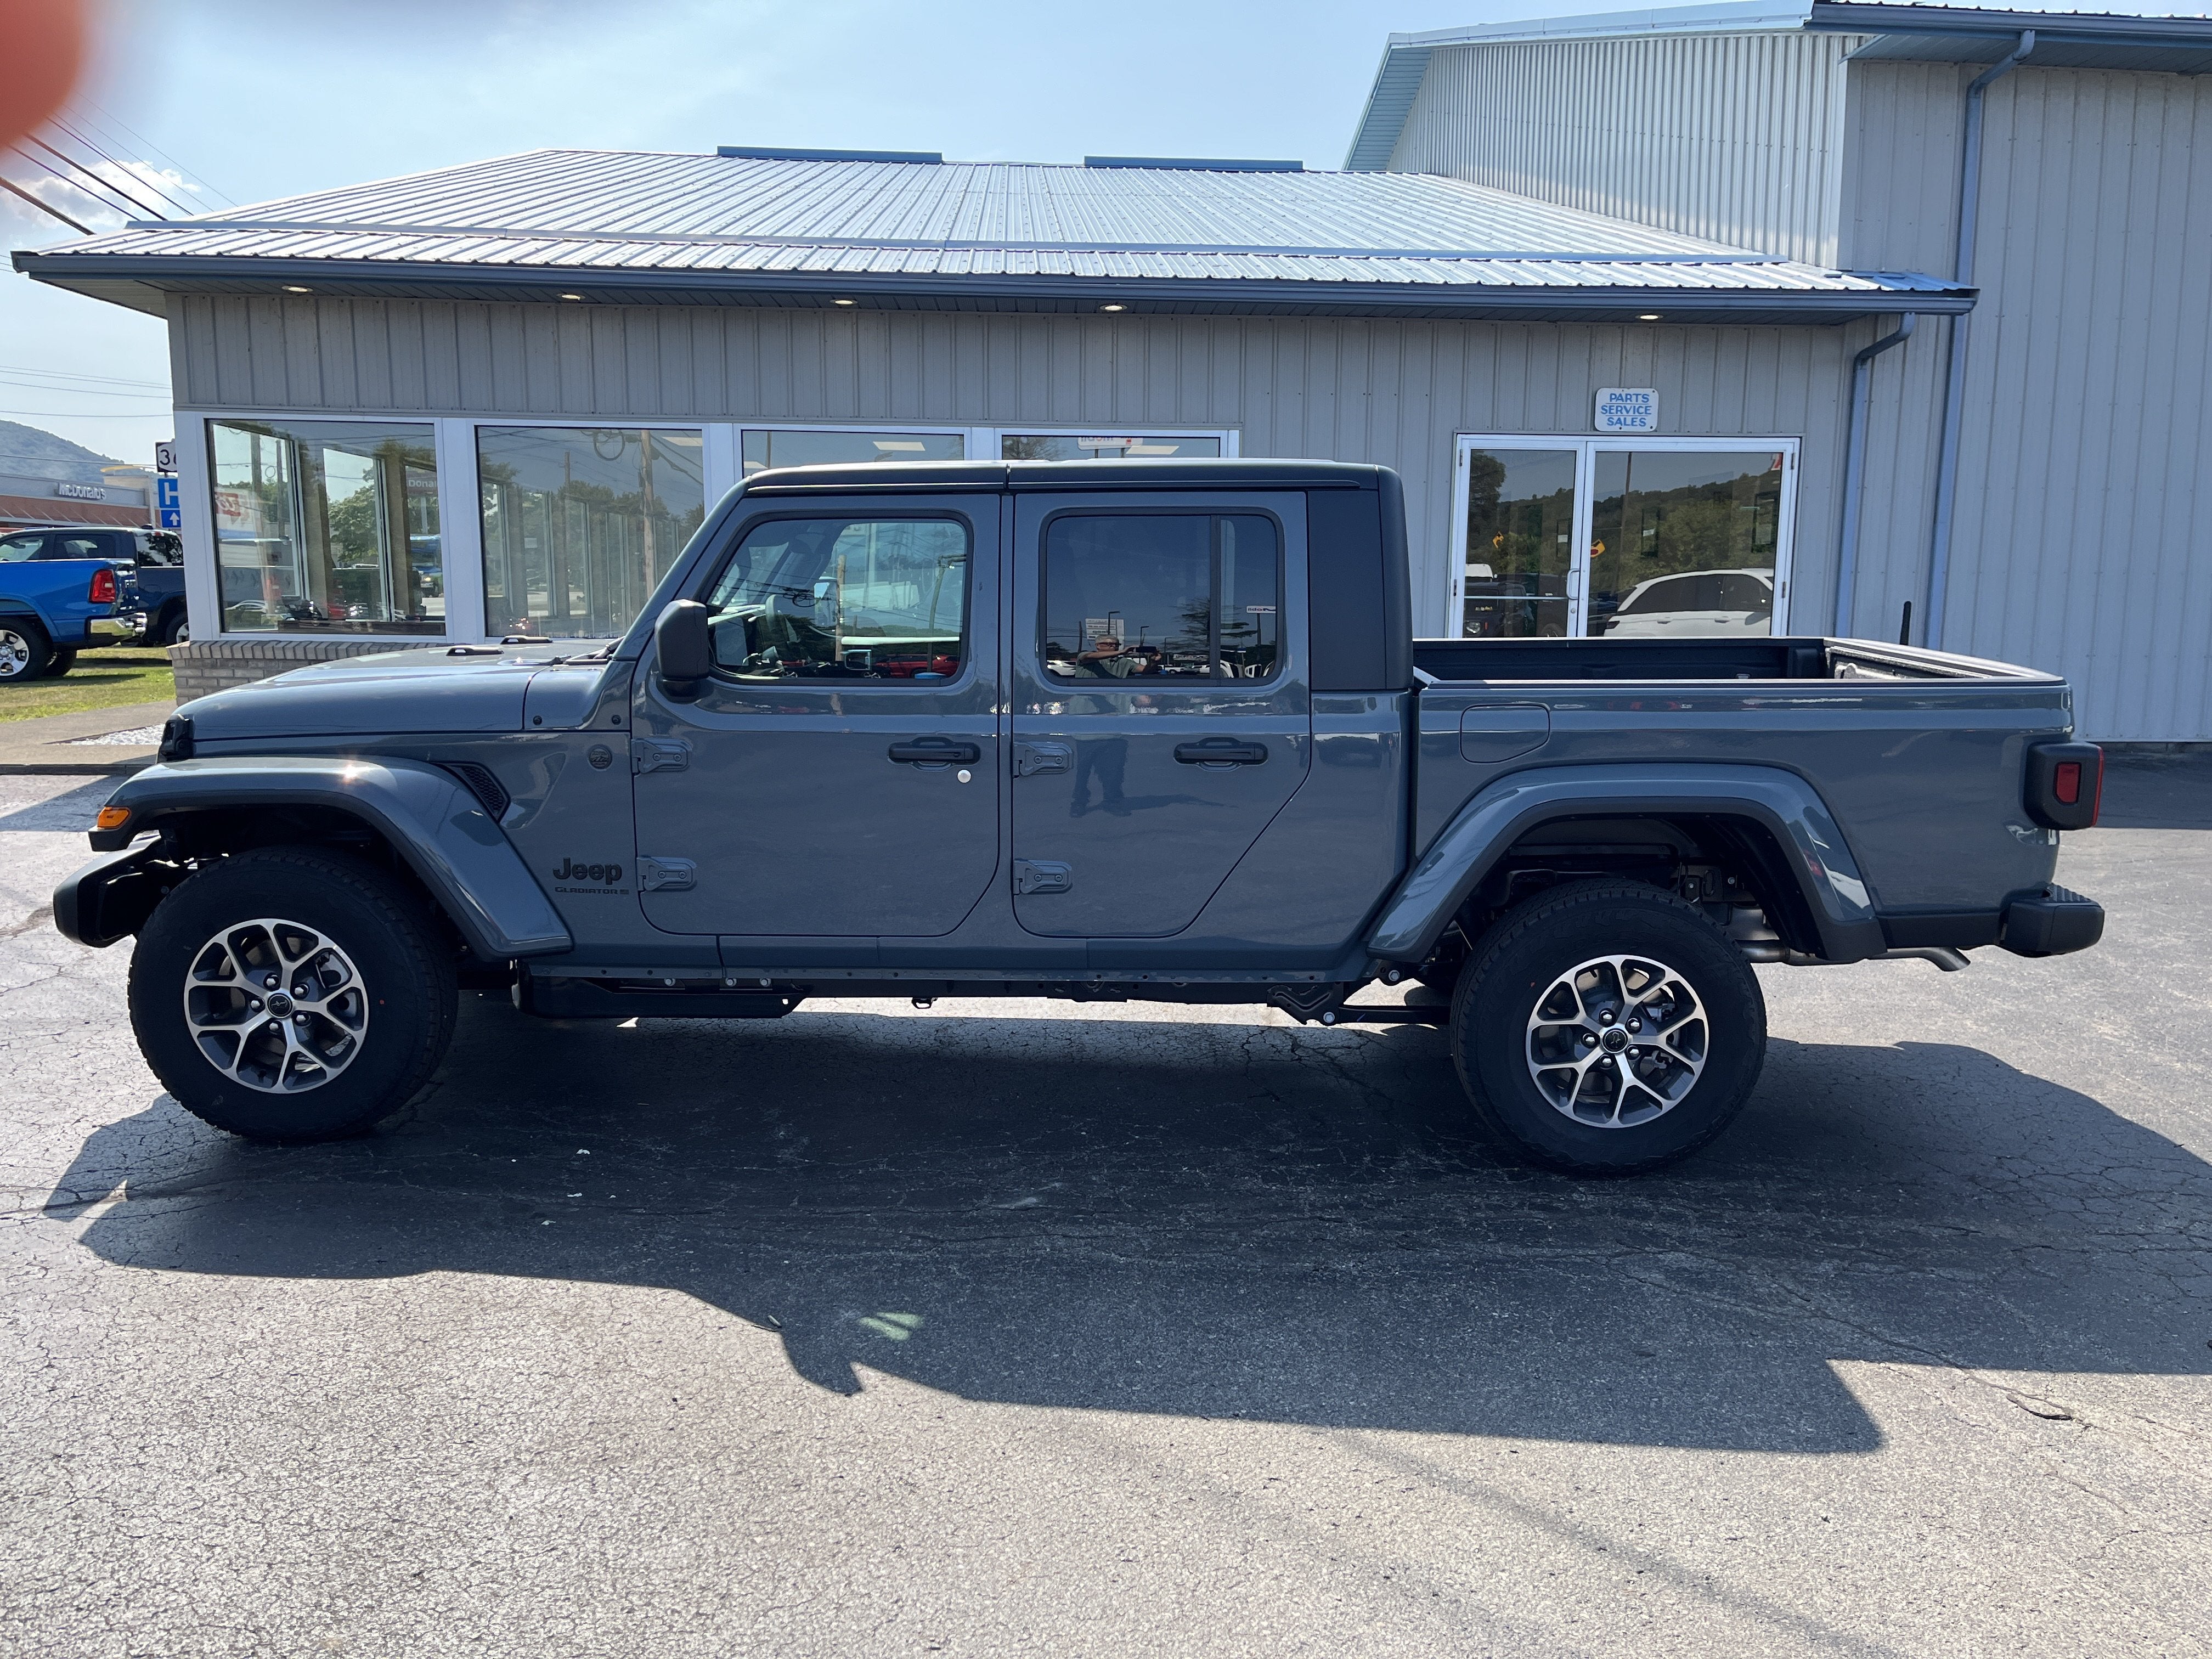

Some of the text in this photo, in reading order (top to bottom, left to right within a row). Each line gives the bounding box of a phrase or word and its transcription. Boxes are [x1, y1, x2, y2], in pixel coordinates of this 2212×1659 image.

[1609, 393, 1650, 403] PARTS
[1600, 405, 1652, 415] SERVICE
[1606, 417, 1647, 427] SALES
[160, 449, 177, 466] 3
[59, 482, 106, 500] McDonald's
[552, 856, 623, 885] Jeep
[554, 887, 619, 895] GLADIATOR
